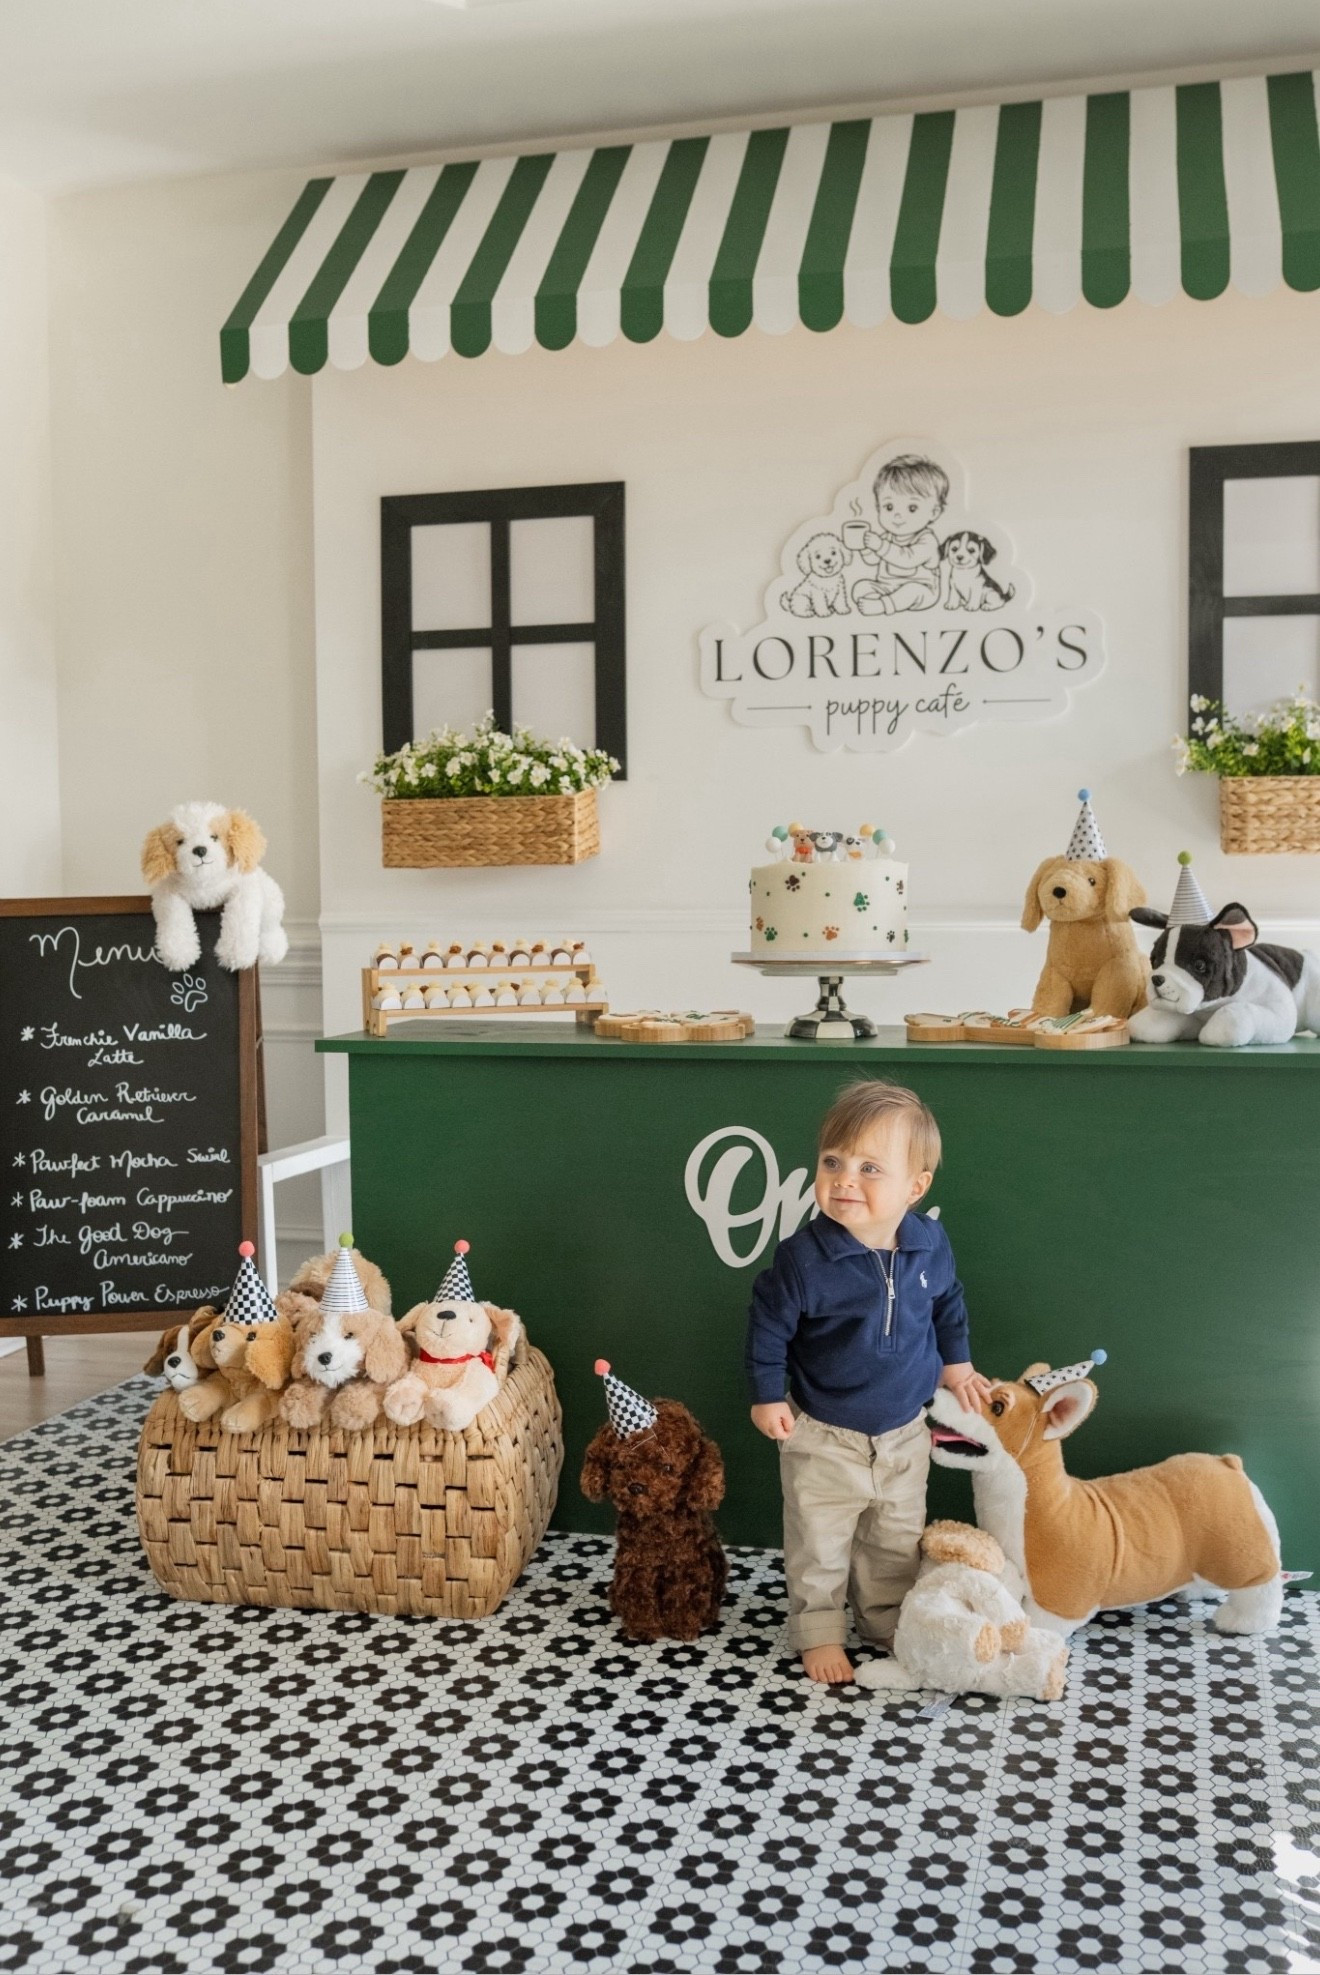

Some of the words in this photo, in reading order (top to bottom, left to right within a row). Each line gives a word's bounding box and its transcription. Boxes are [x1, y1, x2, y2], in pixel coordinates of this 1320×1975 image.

[715, 625, 1089, 683] LORENZO'S
[825, 699, 909, 736] puppy
[915, 682, 970, 719] café
[29, 926, 164, 1000] Menu
[40, 1022, 119, 1050] Frenchie
[122, 1023, 208, 1041] Vanilla
[87, 1048, 144, 1067] Latte
[40, 1086, 109, 1121] Golden
[115, 1081, 197, 1104] Retriever
[76, 1106, 165, 1125] Caramel
[30, 1149, 101, 1178] Pawfect
[109, 1150, 178, 1178] Mocha
[29, 1189, 127, 1214] Paw-foam
[136, 1187, 233, 1213] Cappuccino
[33, 1224, 72, 1247] The
[132, 1221, 190, 1245] Dog
[93, 1248, 193, 1269] Americano
[35, 1286, 95, 1313] Puppy
[99, 1280, 149, 1307] Power
[154, 1284, 231, 1304] Espresso
